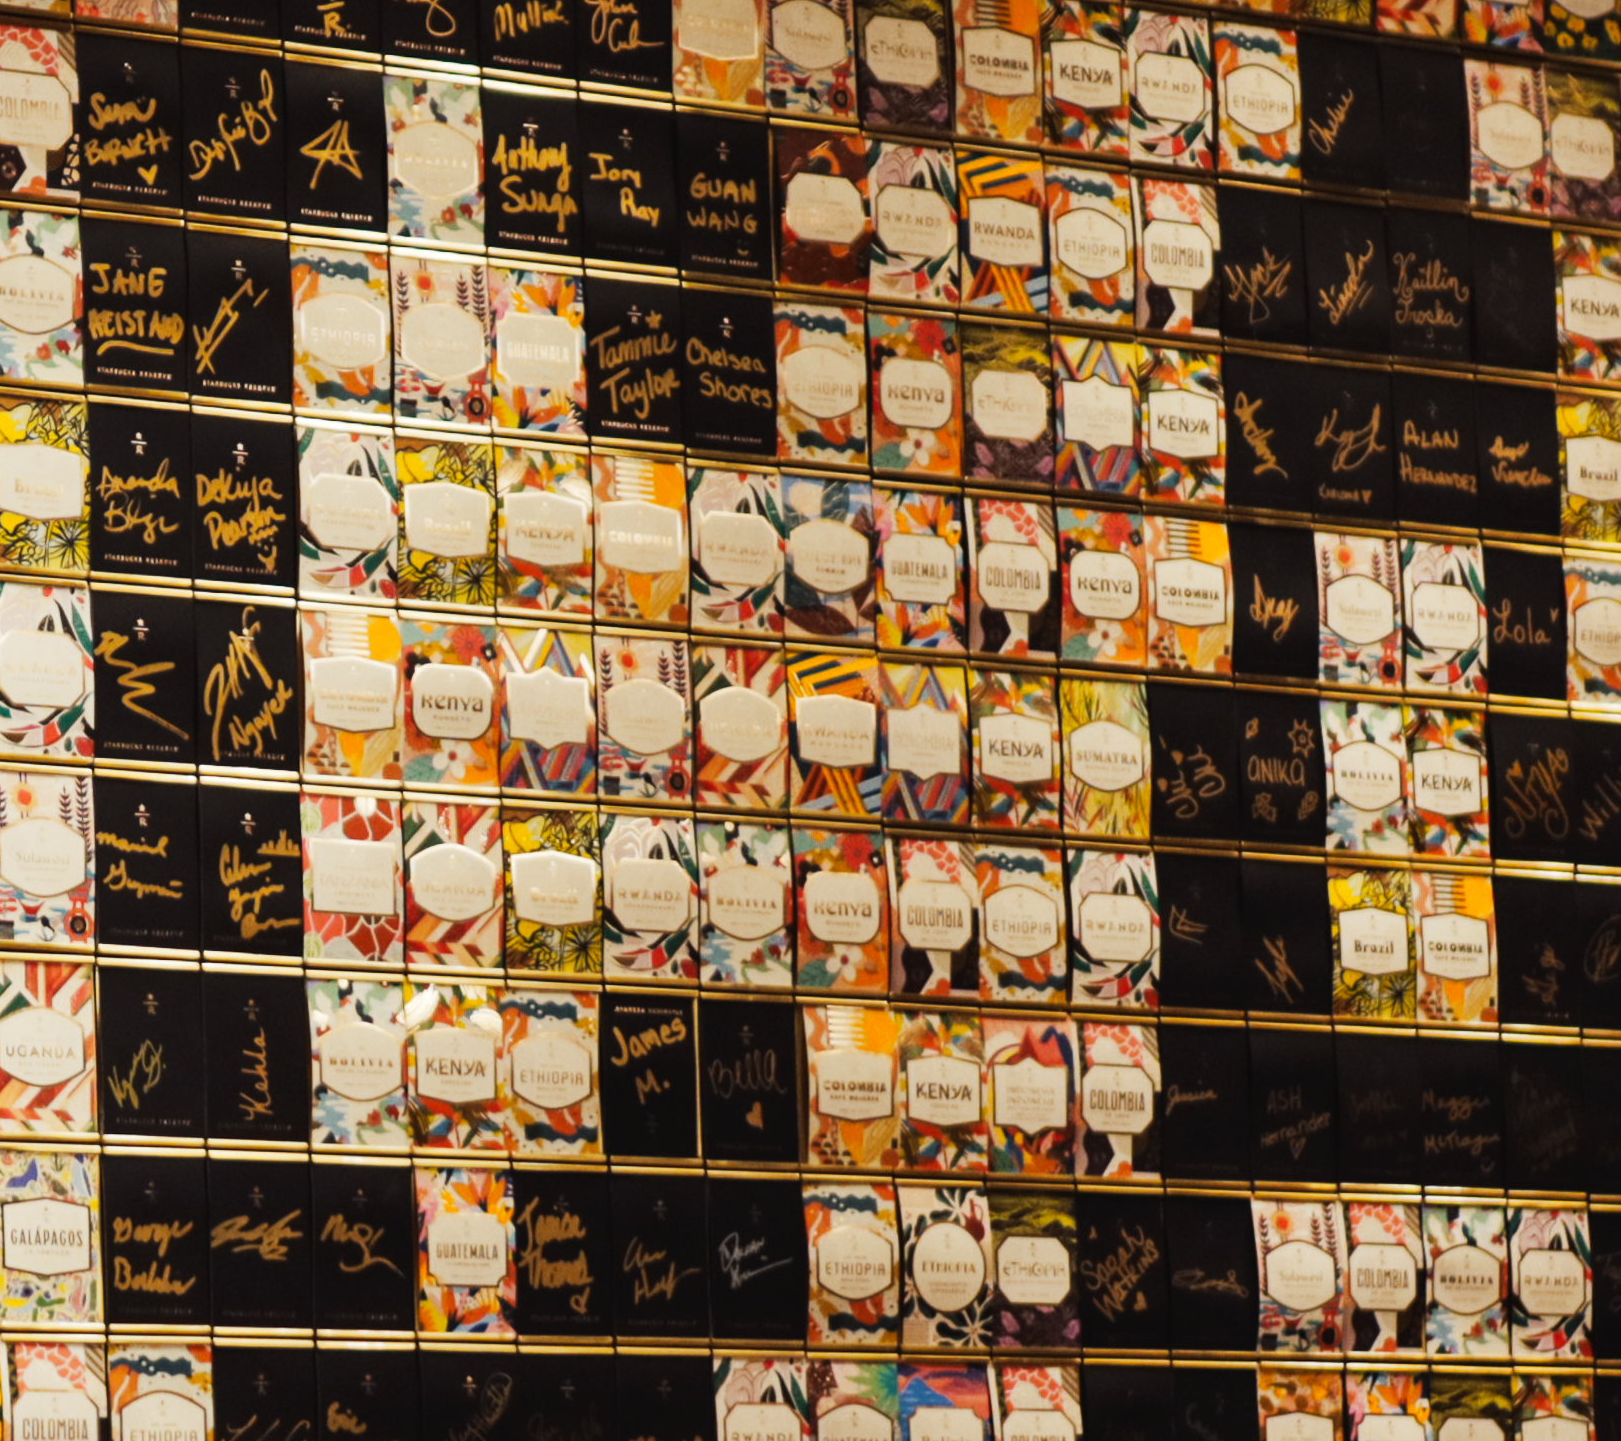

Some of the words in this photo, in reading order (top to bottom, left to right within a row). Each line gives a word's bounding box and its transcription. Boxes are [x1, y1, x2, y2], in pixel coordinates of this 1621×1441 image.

[974, 222, 1035, 240] RWANDA
[1571, 300, 1619, 317] KENYA
[1078, 577, 1132, 594] Kenya
[520, 1070, 584, 1086] ETHIOPIA
[22, 1419, 88, 1441] COLOMBIA
